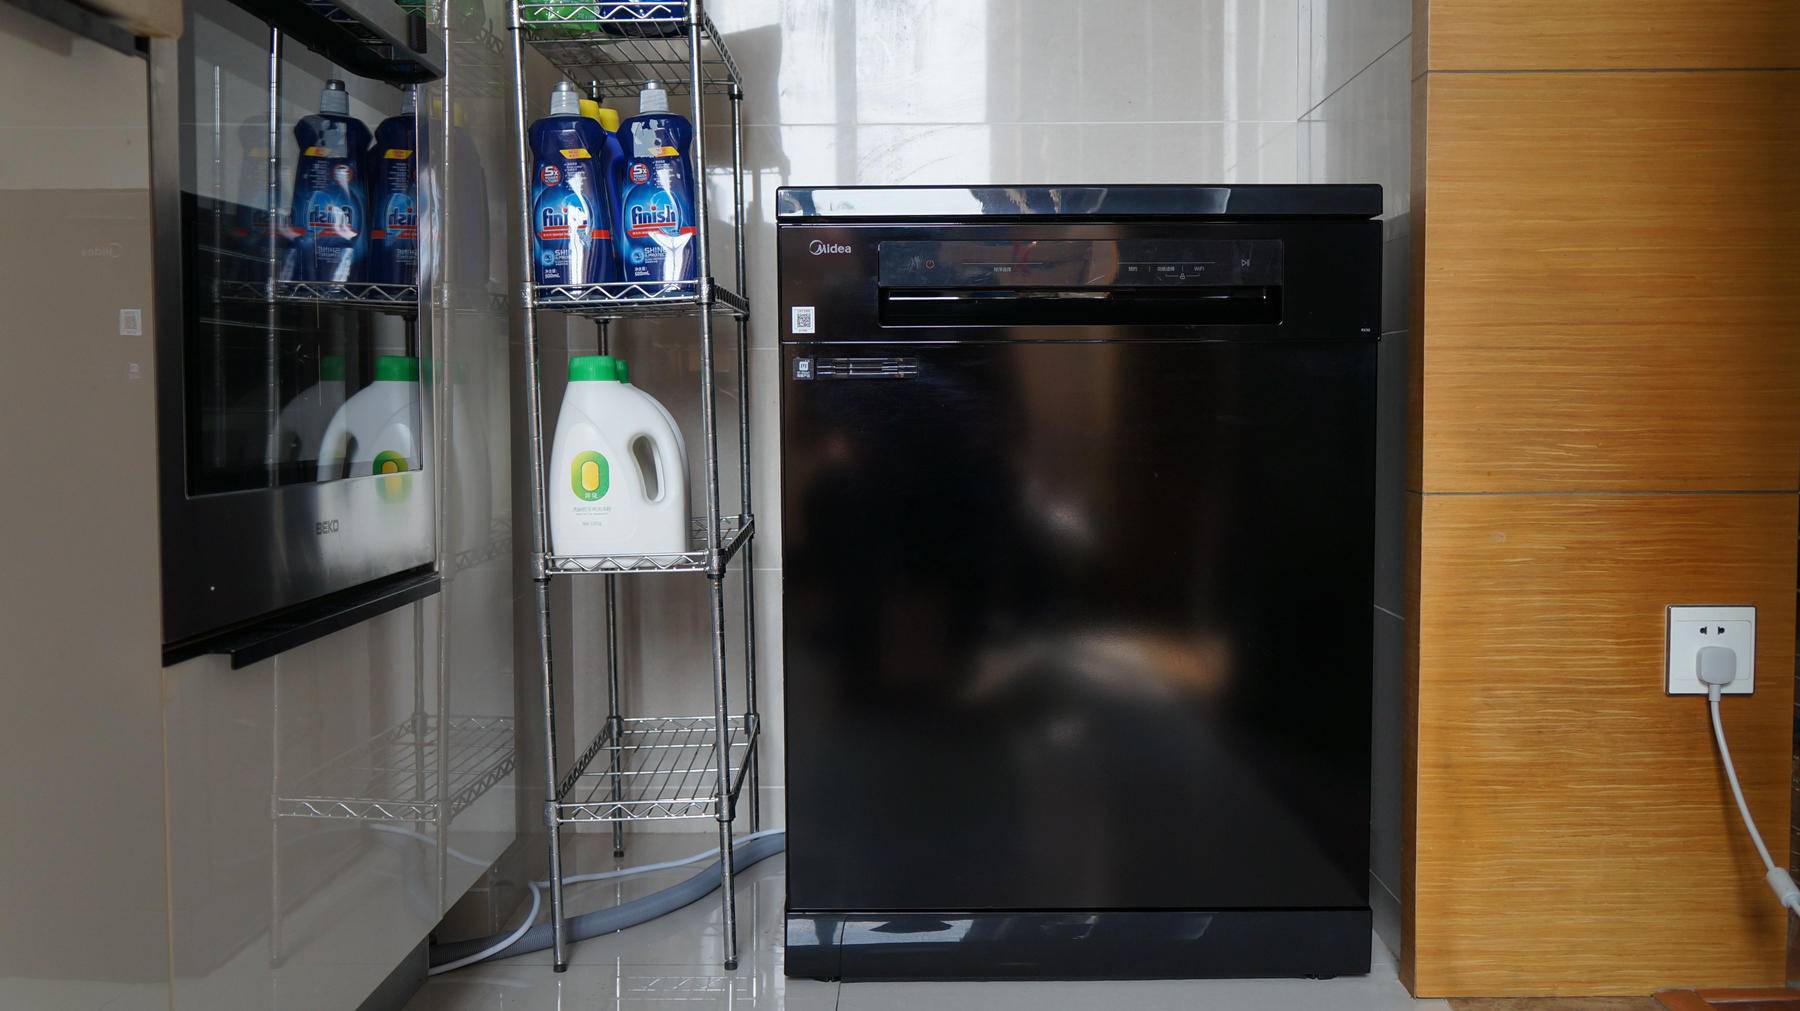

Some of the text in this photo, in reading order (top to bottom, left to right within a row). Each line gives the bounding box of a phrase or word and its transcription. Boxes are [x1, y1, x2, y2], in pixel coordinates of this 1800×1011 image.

[542, 207, 588, 227] fini
[630, 203, 677, 226] finish
[809, 240, 852, 256] Midea
[315, 519, 340, 535] BEKO
